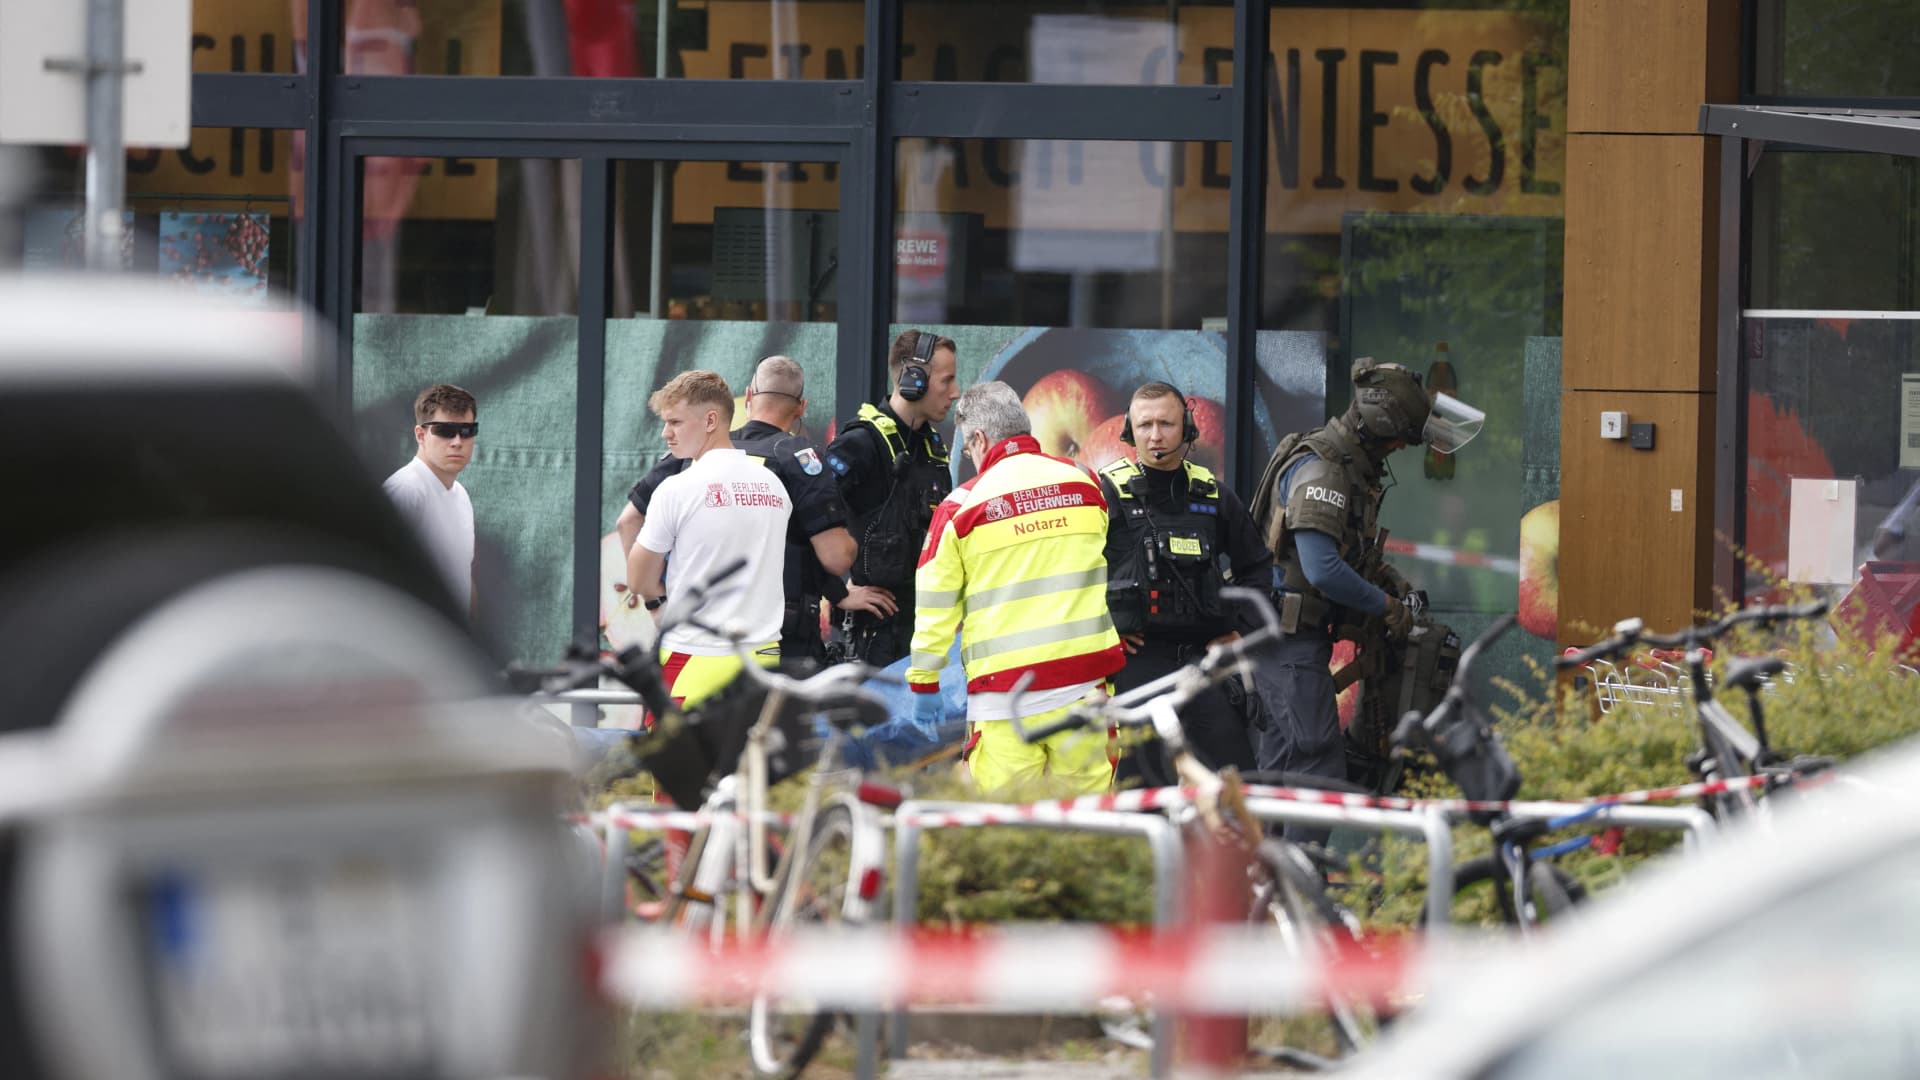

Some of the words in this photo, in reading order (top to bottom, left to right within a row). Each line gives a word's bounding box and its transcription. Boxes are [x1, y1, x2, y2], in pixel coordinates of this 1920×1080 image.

[896, 239, 937, 253] REWE
[732, 482, 770, 493] BERLINER
[1012, 484, 1061, 501] BERLINER
[734, 493, 784, 510] FEUERWEHR
[1016, 493, 1084, 514] FEUERWEHR
[1305, 486, 1346, 510] POLIZEI
[1013, 516, 1069, 536] Notarzt
